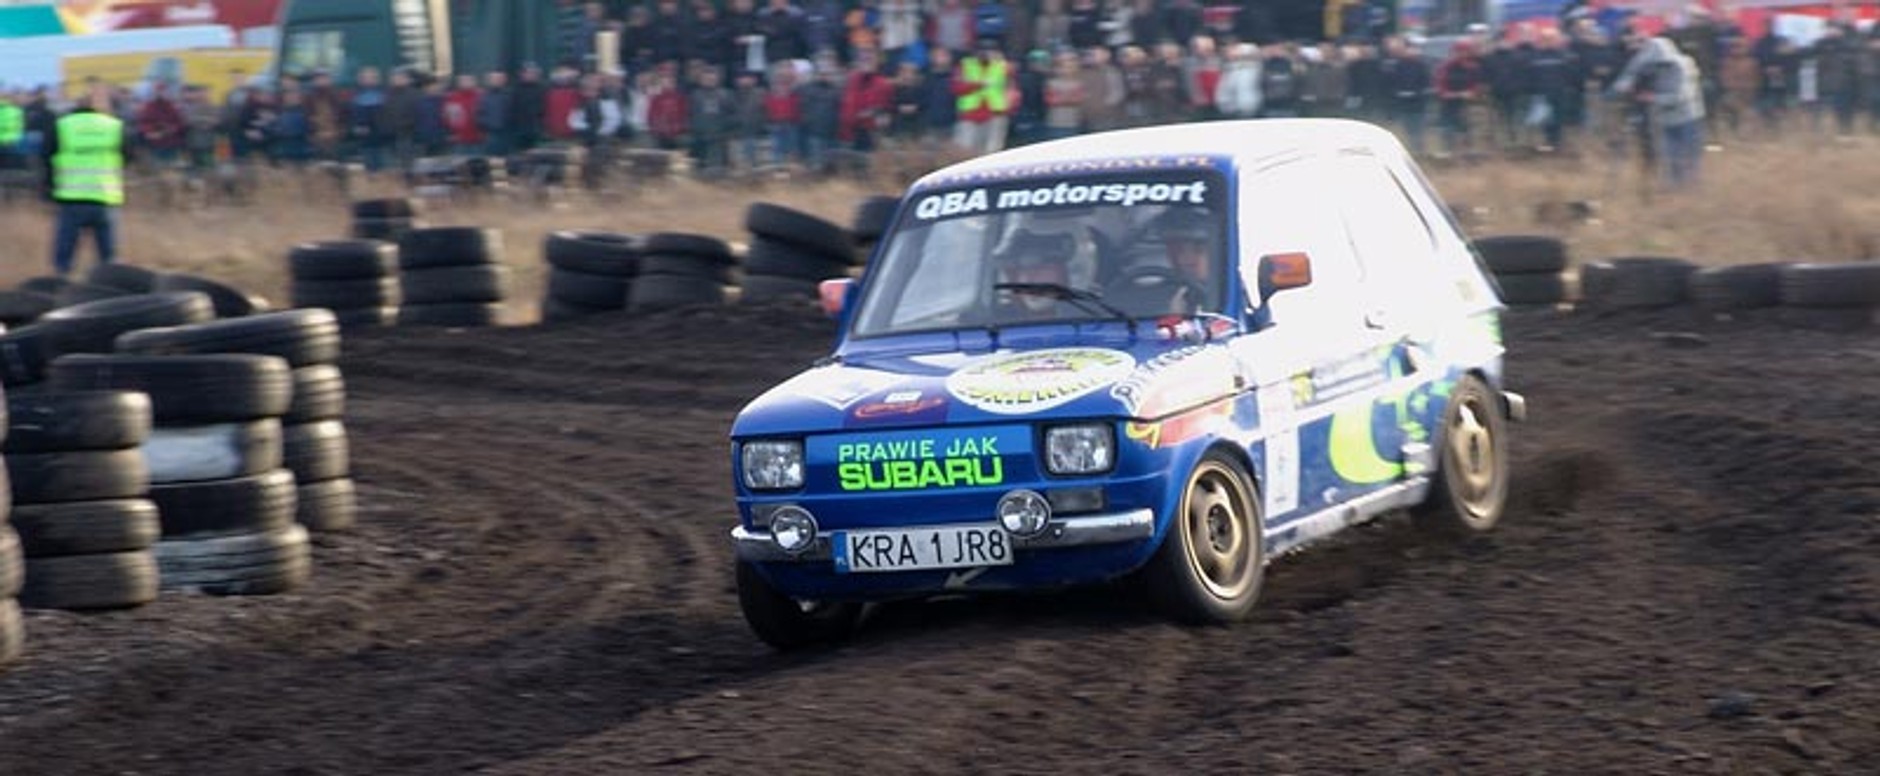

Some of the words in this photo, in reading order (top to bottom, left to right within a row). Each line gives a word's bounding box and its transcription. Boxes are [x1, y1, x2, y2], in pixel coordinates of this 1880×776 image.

[916, 189, 988, 219] QBA
[996, 181, 1206, 207] motorsport
[838, 439, 935, 463] PRAWIE
[946, 436, 998, 458] JAK
[838, 457, 1003, 490] SUBARU
[852, 533, 918, 567] KRA
